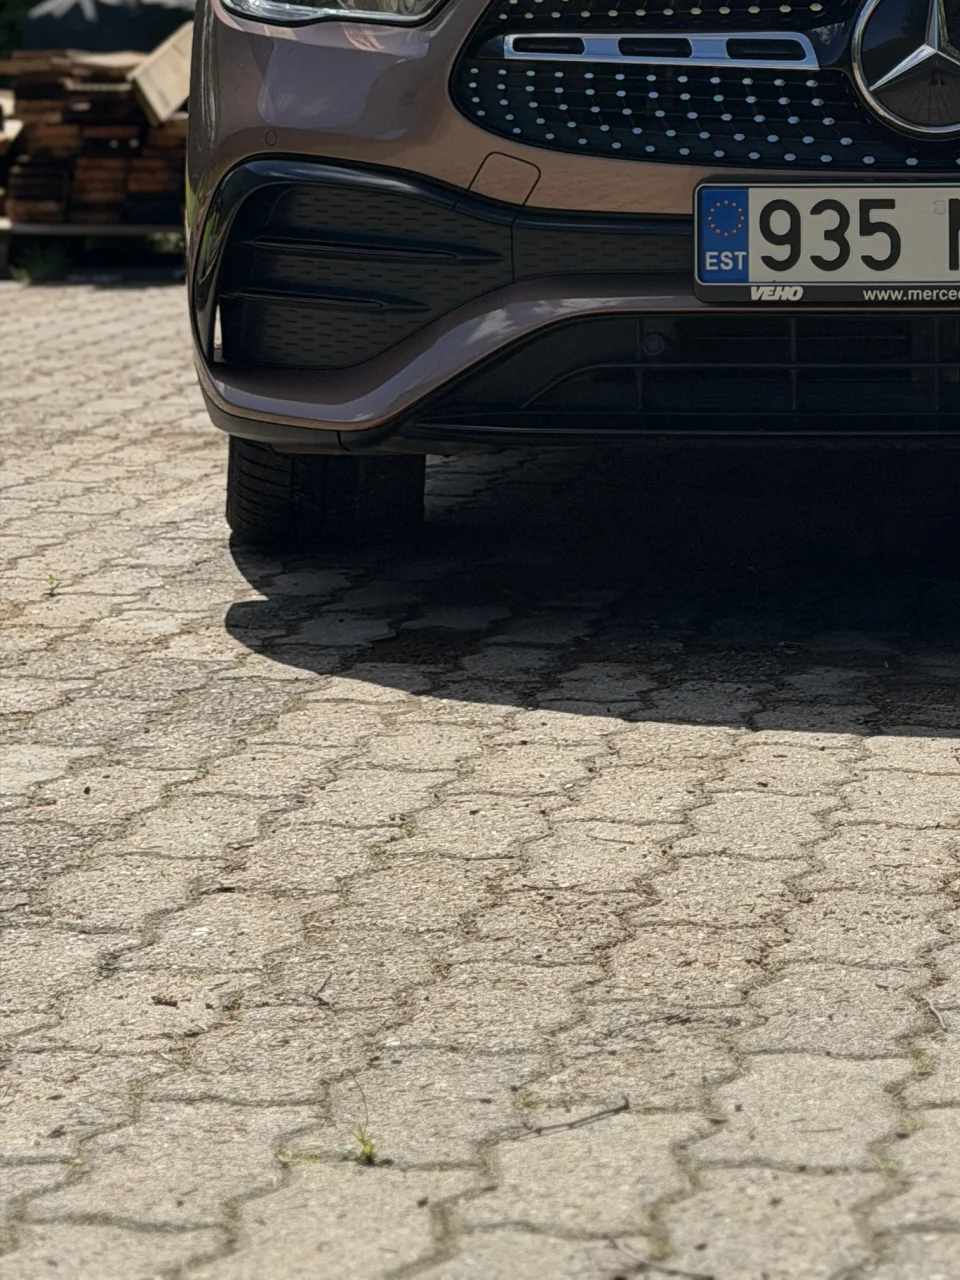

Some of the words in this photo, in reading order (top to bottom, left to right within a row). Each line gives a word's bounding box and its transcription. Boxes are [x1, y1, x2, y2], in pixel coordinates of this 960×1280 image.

[759, 198, 901, 271] 935
[705, 251, 747, 271] EST
[750, 286, 804, 301] VEHO
